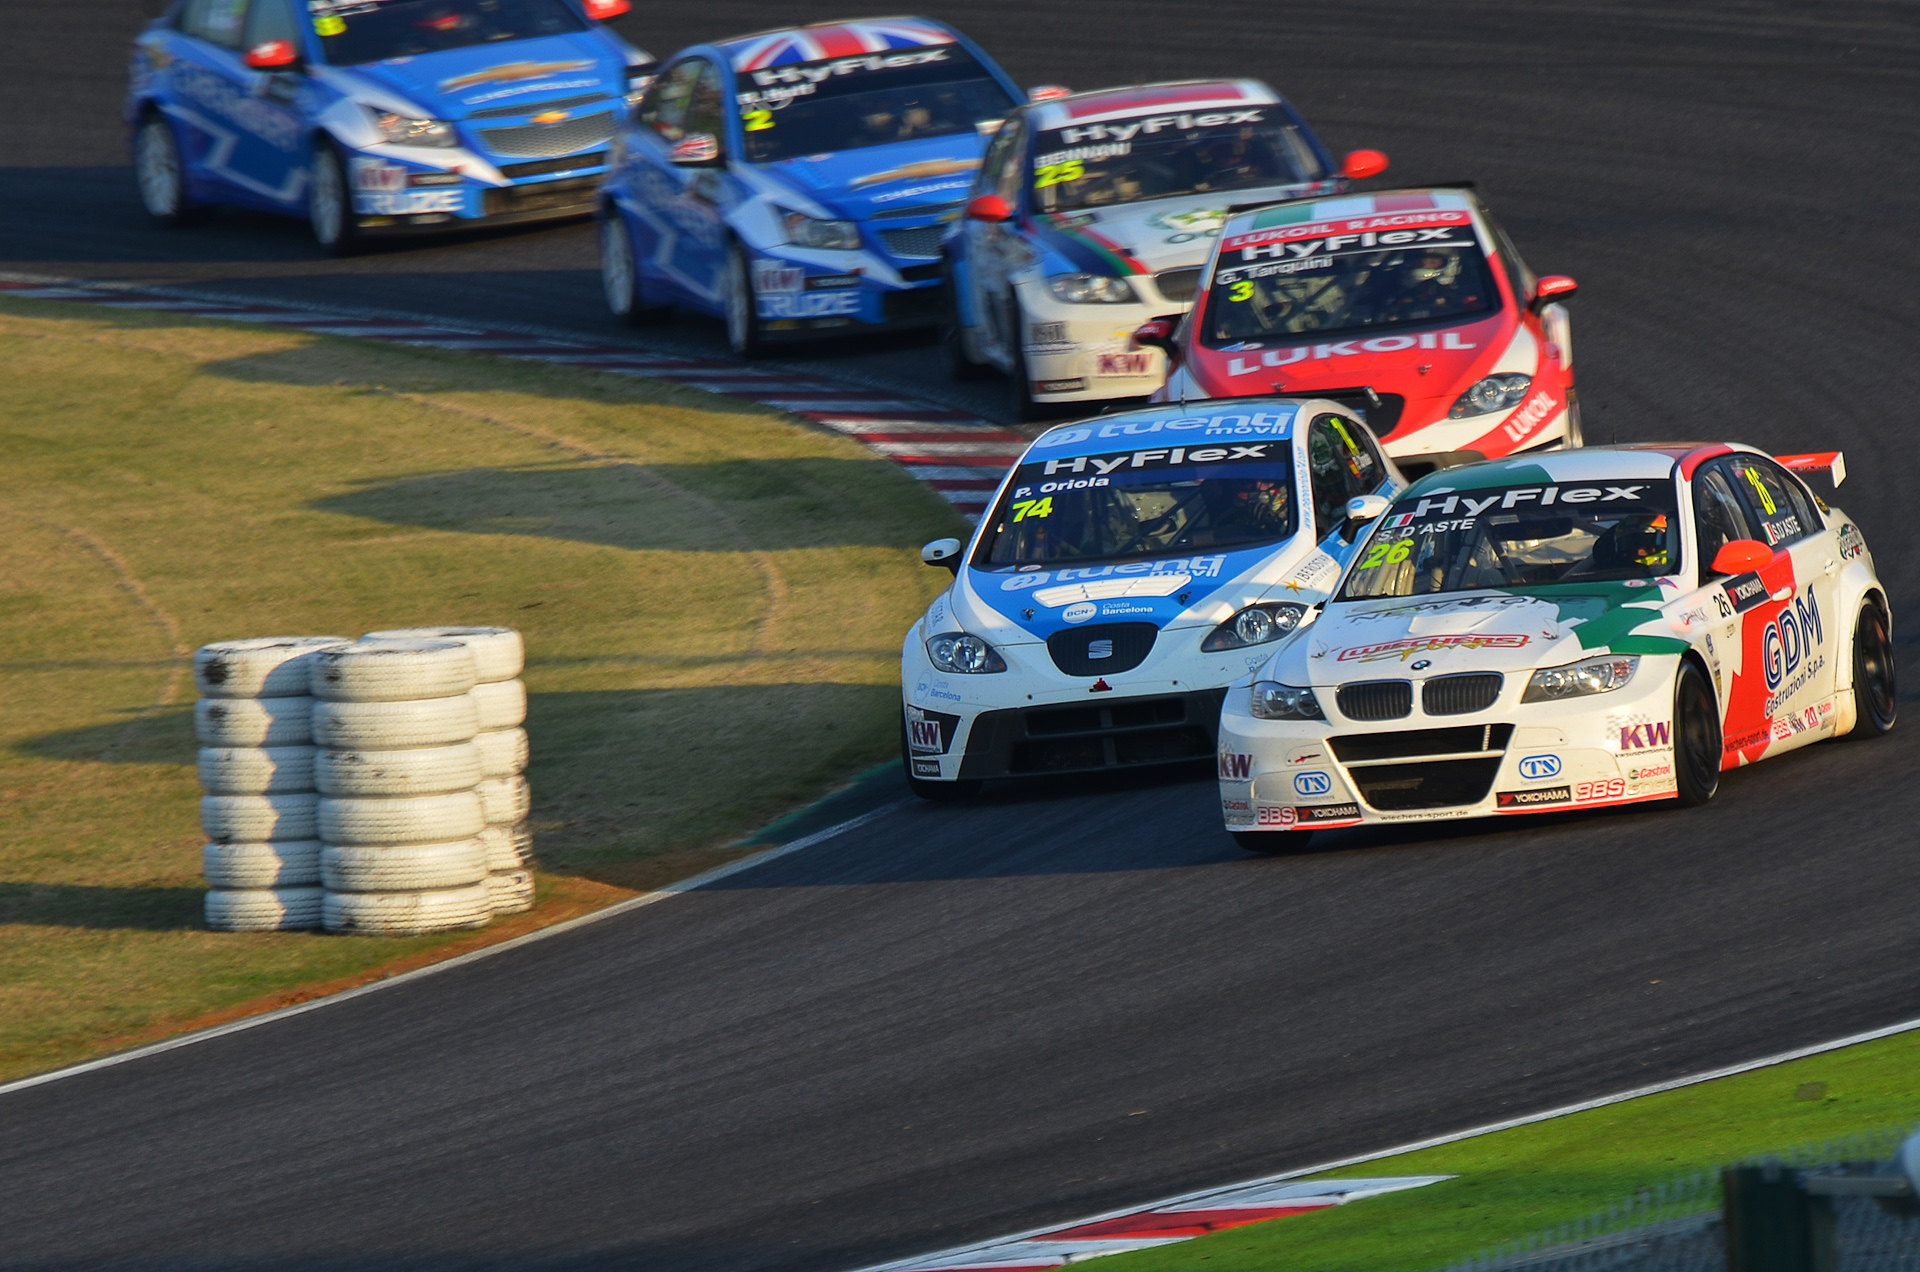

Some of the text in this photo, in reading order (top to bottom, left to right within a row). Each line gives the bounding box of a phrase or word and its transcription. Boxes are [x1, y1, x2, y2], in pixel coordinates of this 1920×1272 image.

[753, 50, 950, 85] HyFlex
[743, 110, 776, 132] 2
[1060, 110, 1265, 144] HyFlex
[1034, 159, 1084, 188] 25
[1233, 211, 1463, 246] LUKOIL RACING
[1242, 226, 1453, 261] HyFlex
[1216, 256, 1333, 286] G. Tarquini
[1229, 281, 1255, 302] 3
[1227, 333, 1477, 376] LUKOIL
[1099, 412, 1293, 438] tuenti
[1503, 391, 1557, 442] LUKOIL
[1043, 444, 1268, 475] HyFlex
[1015, 476, 1109, 498] P. Oriola
[1012, 497, 1053, 523] 74
[1414, 485, 1644, 517] HyFlex
[1377, 529, 1394, 541] S.
[1360, 539, 1415, 570] 26
[1056, 554, 1227, 582] tuenti
[1067, 609, 1090, 618] BCN
[1102, 605, 1153, 616] Barcelona
[1713, 593, 1732, 618] 26
[1764, 583, 1823, 691] GDM
[930, 688, 961, 702] Barcelona
[1766, 667, 1807, 718] Costruzioni
[911, 721, 939, 747] KW
[1620, 721, 1671, 750] KW
[1220, 753, 1252, 778] KW
[1640, 764, 1671, 779] Castrol
[1515, 788, 1569, 802] YOKOHAMA
[1576, 778, 1625, 802] BBS
[1257, 806, 1297, 825] BBS
[1311, 806, 1359, 818] YOKOHAMA
[1380, 810, 1469, 821] wiechers-sport.de
